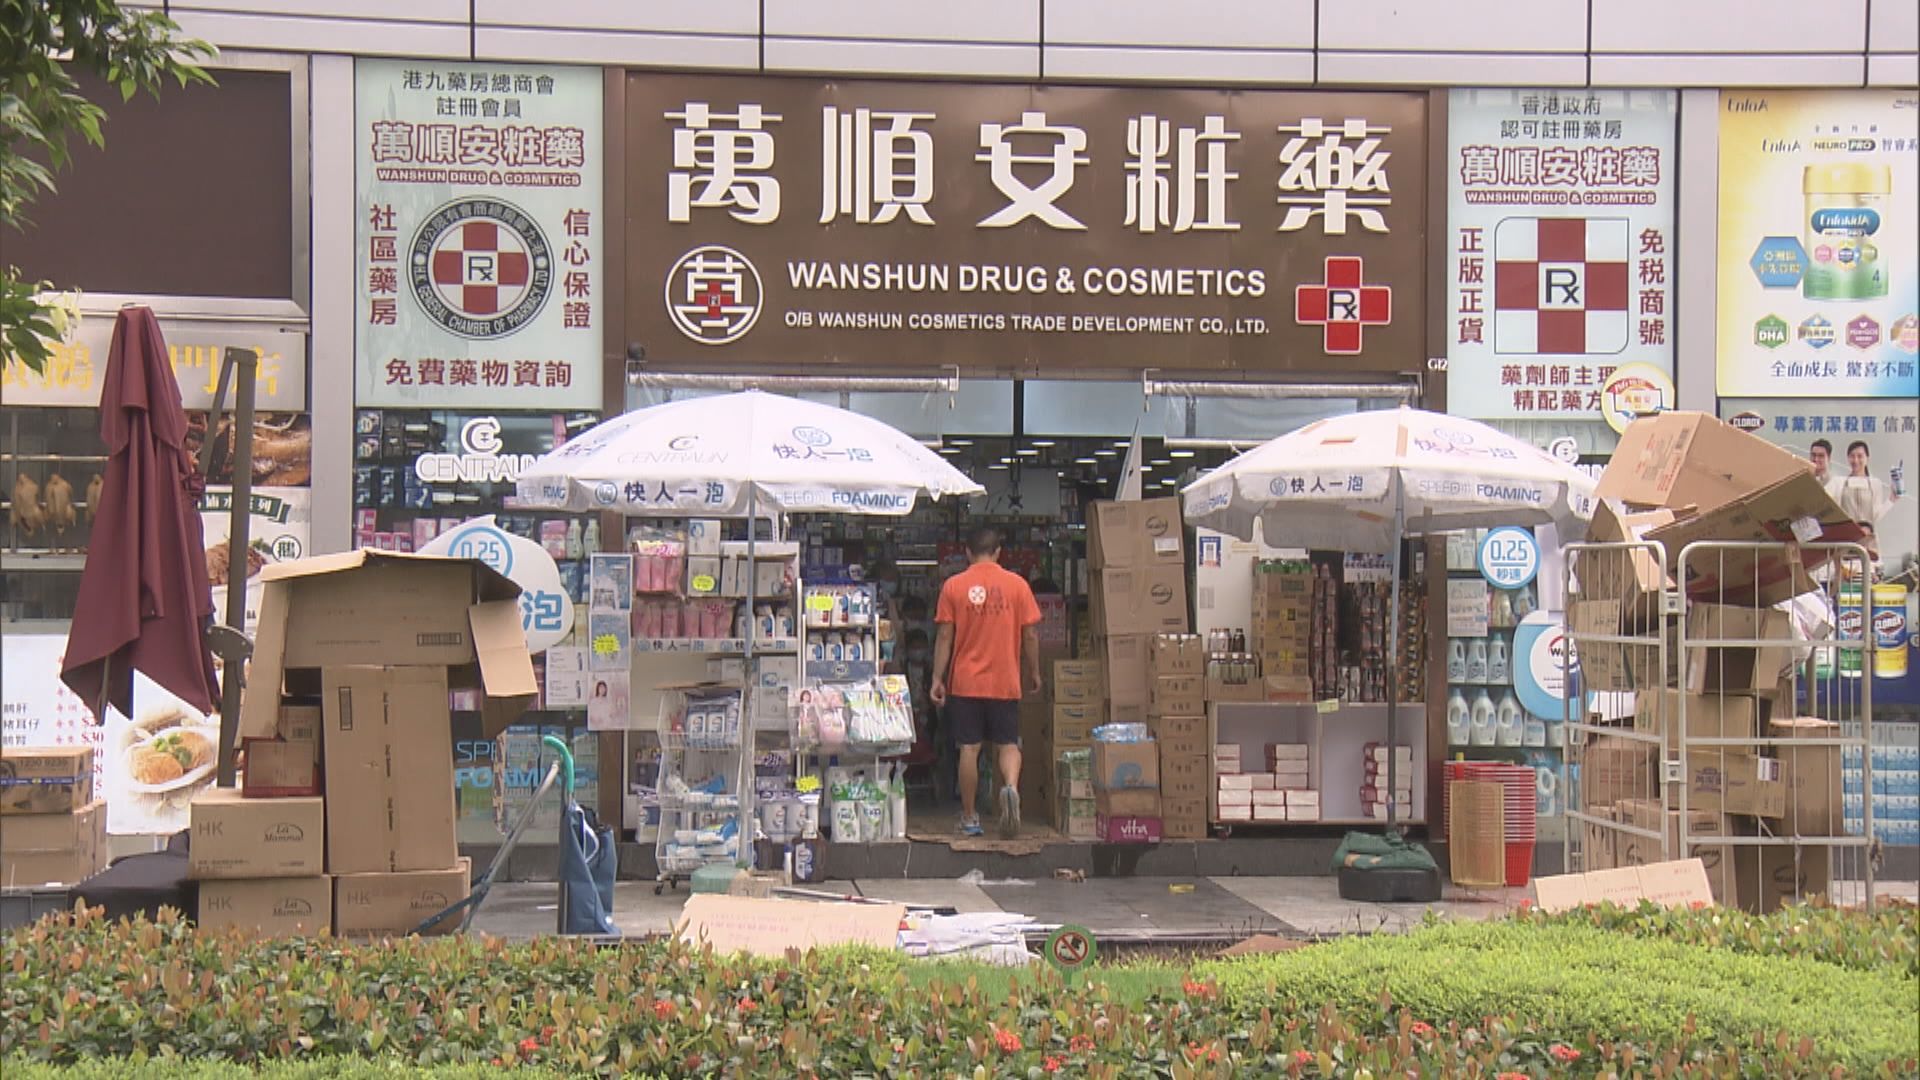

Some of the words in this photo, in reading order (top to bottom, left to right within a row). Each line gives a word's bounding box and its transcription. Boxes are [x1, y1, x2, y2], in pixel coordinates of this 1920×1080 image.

[403, 70, 554, 95] 港九藥房總商會
[436, 97, 521, 118] 註冊會員
[1522, 95, 1602, 116] 香港政府
[1500, 119, 1623, 140] 認可註冊藥房
[372, 121, 584, 167] 萬順安粧藥
[662, 101, 1393, 235] 萬順安粧藥
[1461, 145, 1660, 187] 萬順安粧藥
[377, 168, 446, 183] WANSHUN
[449, 170, 488, 184] DRUG
[490, 171, 501, 184] &
[503, 172, 581, 186] COSMETICS
[1466, 190, 1529, 204] WANSHUN
[1531, 190, 1569, 204] DRUG
[1569, 191, 1582, 204] &
[1583, 191, 1656, 205] COSMETICS
[369, 203, 398, 326] 社區藥房
[563, 208, 591, 330] 信心保證
[788, 262, 949, 291] WANSHUN
[959, 264, 1048, 293] DRUG
[1055, 267, 1077, 294] &
[1083, 267, 1266, 296] COSMETICS
[1458, 227, 1484, 346] 正版正貨
[446, 313, 491, 335] CHAMBER
[785, 311, 813, 328] O/B
[818, 312, 903, 329] WANSHUN
[908, 314, 1006, 330] COSMETICS
[1011, 315, 1067, 331] TRADE
[1072, 316, 1194, 333] DEVELOPMENT
[1758, 329, 1784, 342] DHA
[386, 358, 573, 388] 免費藥物資詢
[1771, 360, 1838, 379] 全面成長
[1846, 360, 1915, 379] 驚喜不斷
[1774, 416, 1877, 433] 專業清潔殺菌
[624, 480, 724, 503] 快人一泡
[1290, 476, 1364, 493] 快人一泡
[1476, 484, 1542, 503] FOAMING
[832, 491, 908, 508] FOAMING
[1490, 539, 1528, 561] 0.25
[199, 821, 223, 836] HK
[208, 896, 233, 911] HK
